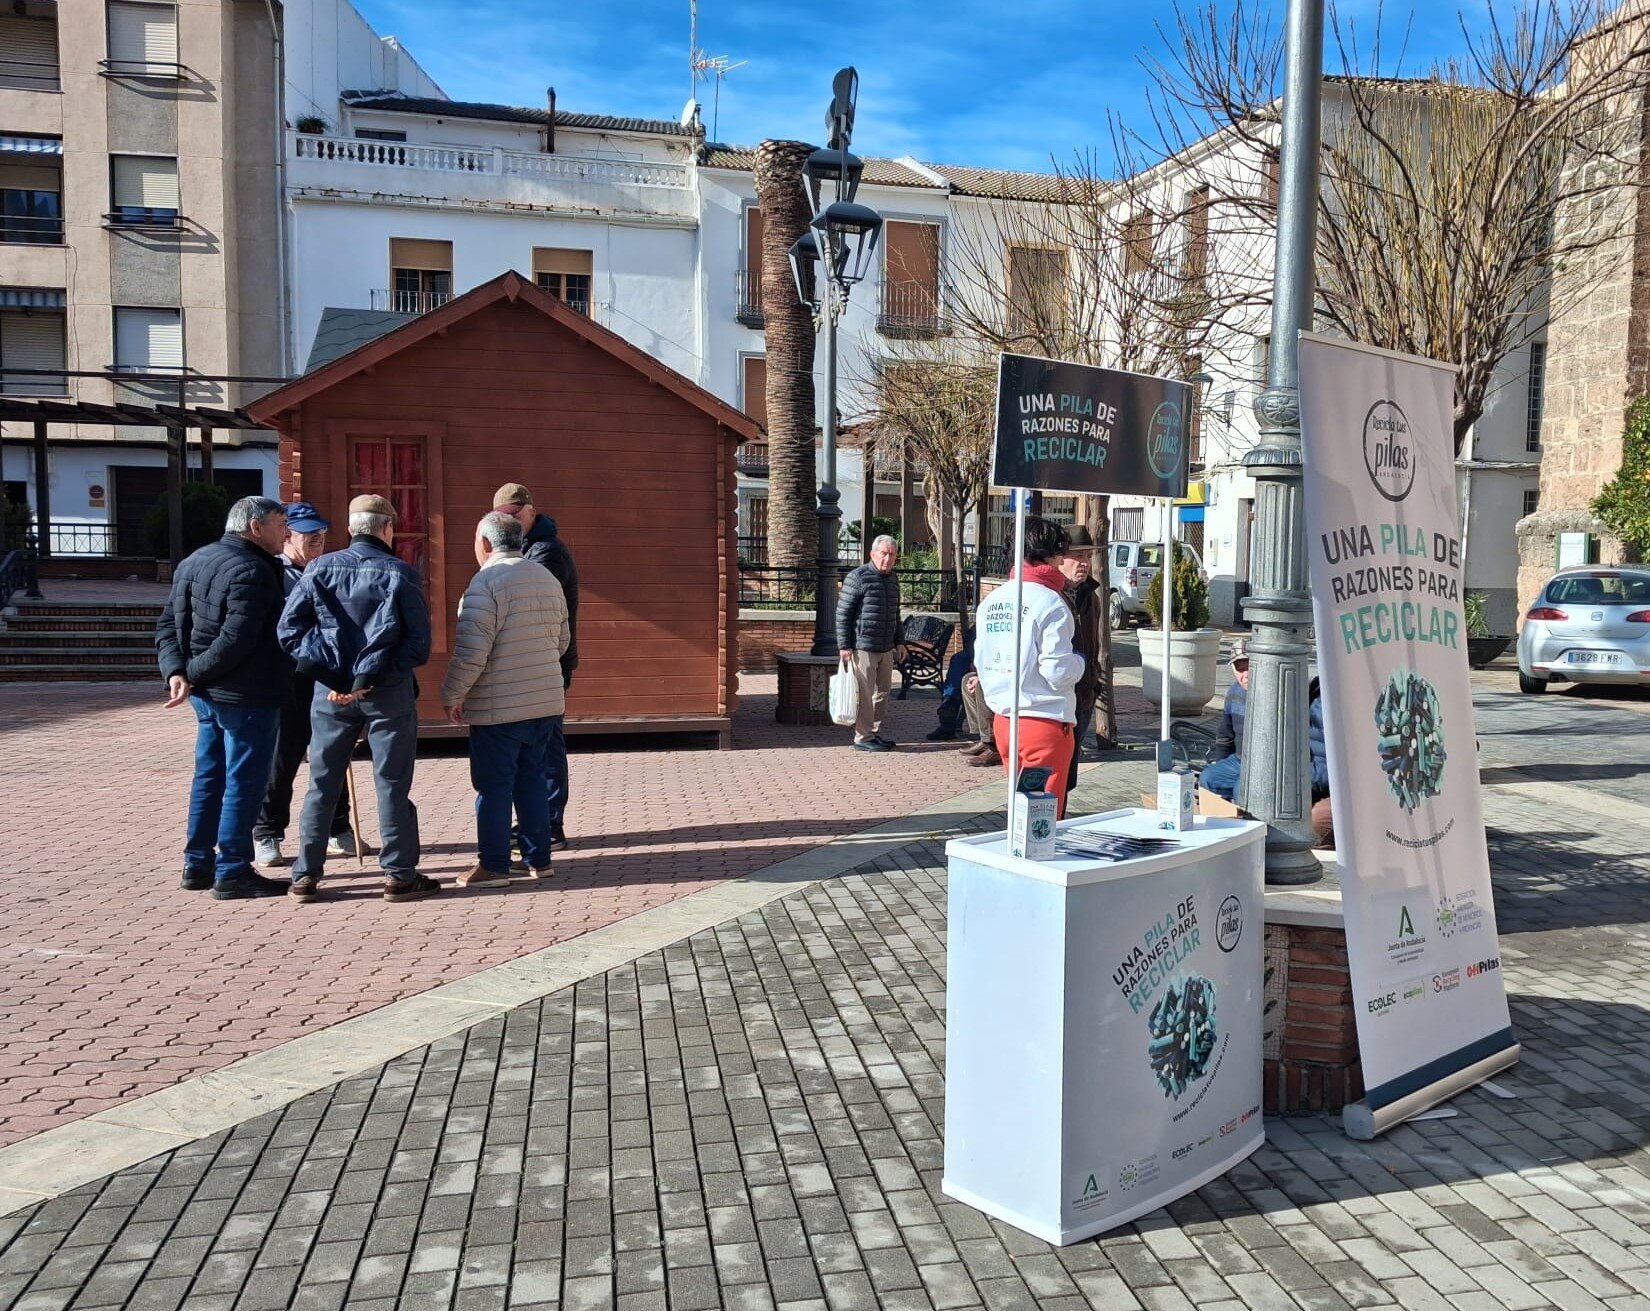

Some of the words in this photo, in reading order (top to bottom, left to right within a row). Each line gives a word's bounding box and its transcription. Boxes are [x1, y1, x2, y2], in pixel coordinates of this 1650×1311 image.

[1019, 393, 1056, 414] UNA
[1060, 393, 1093, 416] PILA
[1096, 401, 1118, 425] DE
[1021, 416, 1080, 435] RAZONES
[1082, 420, 1111, 444] PARA
[1023, 436, 1107, 469] RECICLAR
[1375, 433, 1408, 477] pilas
[1321, 524, 1376, 565] UNA
[1380, 523, 1427, 558] PILA
[1433, 532, 1460, 569] DE
[1331, 565, 1414, 604] RAZONES
[1418, 568, 1459, 603] PARA
[987, 602, 1004, 613] UNA
[1339, 601, 1458, 654] RECICLAR
[1112, 946, 1144, 986] UNA
[1144, 912, 1175, 948] PILA
[1177, 895, 1195, 920] DE
[1121, 937, 1170, 998] RAZONES
[1170, 913, 1198, 942] PARA
[1128, 928, 1201, 1015] RECICLAR
[1367, 992, 1397, 1013] ECOLEC
